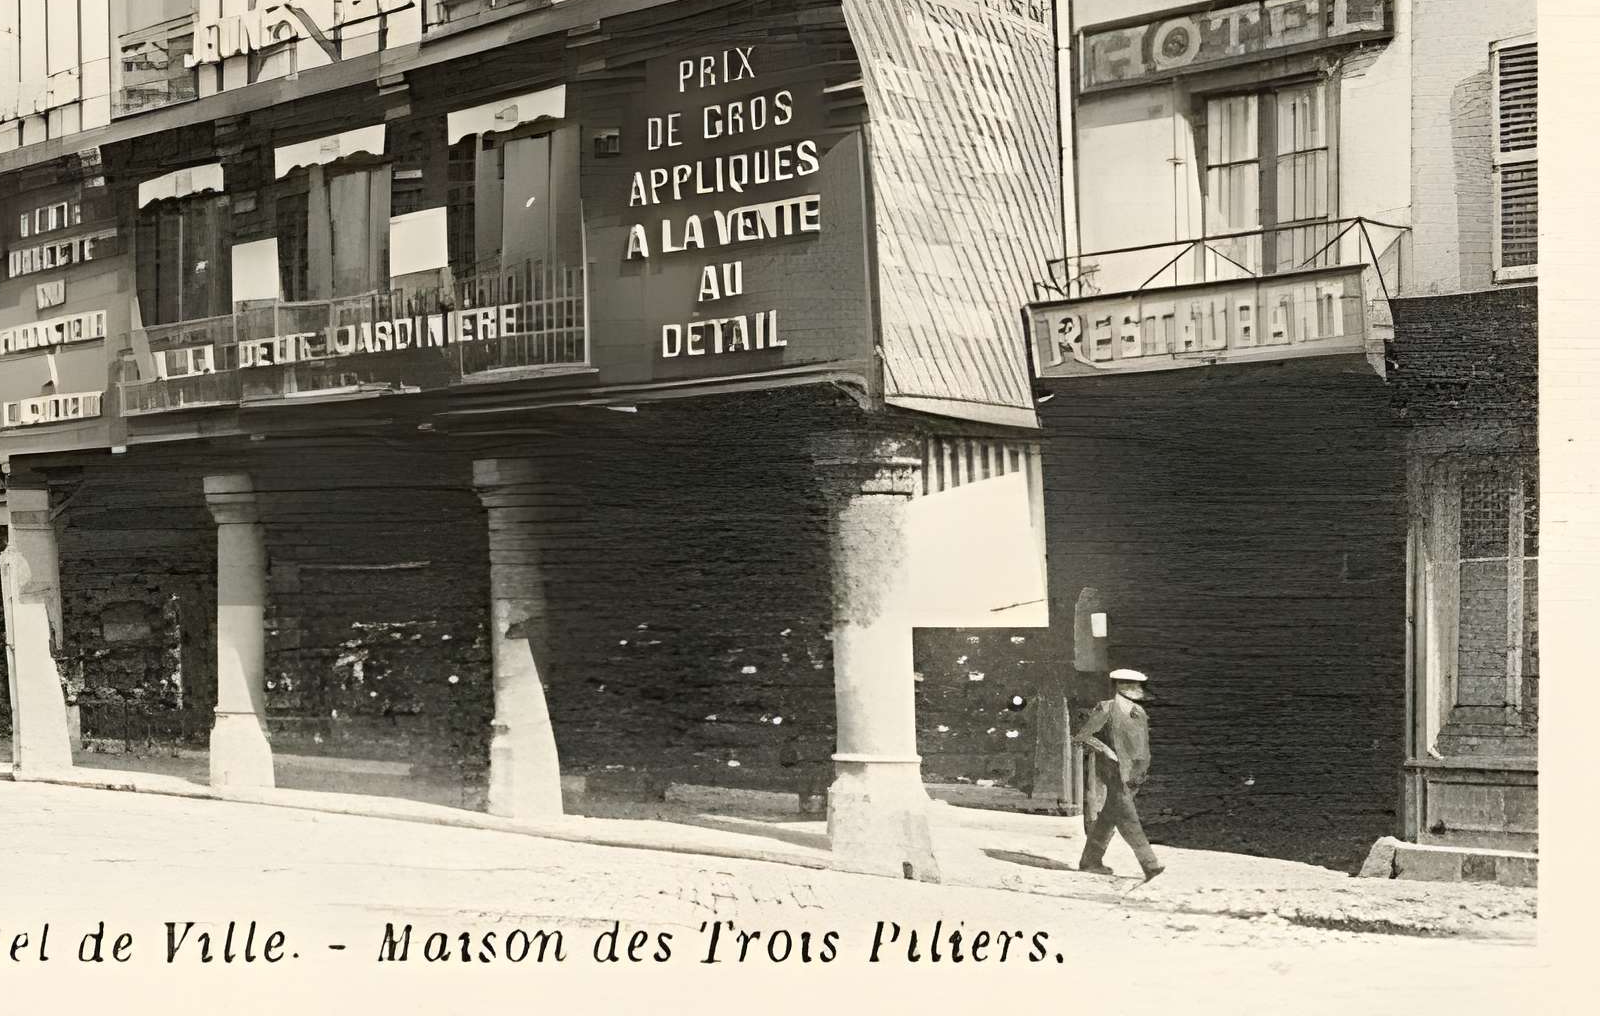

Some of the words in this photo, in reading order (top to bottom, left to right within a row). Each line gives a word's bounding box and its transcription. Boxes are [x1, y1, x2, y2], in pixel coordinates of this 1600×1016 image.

[679, 47, 757, 93] PRIX
[647, 112, 683, 152] DE
[703, 90, 793, 140] GROS
[629, 139, 820, 208] APPLIQUES
[626, 223, 649, 261] A
[662, 213, 705, 254] LA
[712, 194, 821, 246] VENTE
[697, 260, 743, 303] AU
[662, 309, 787, 358] DETAIL
